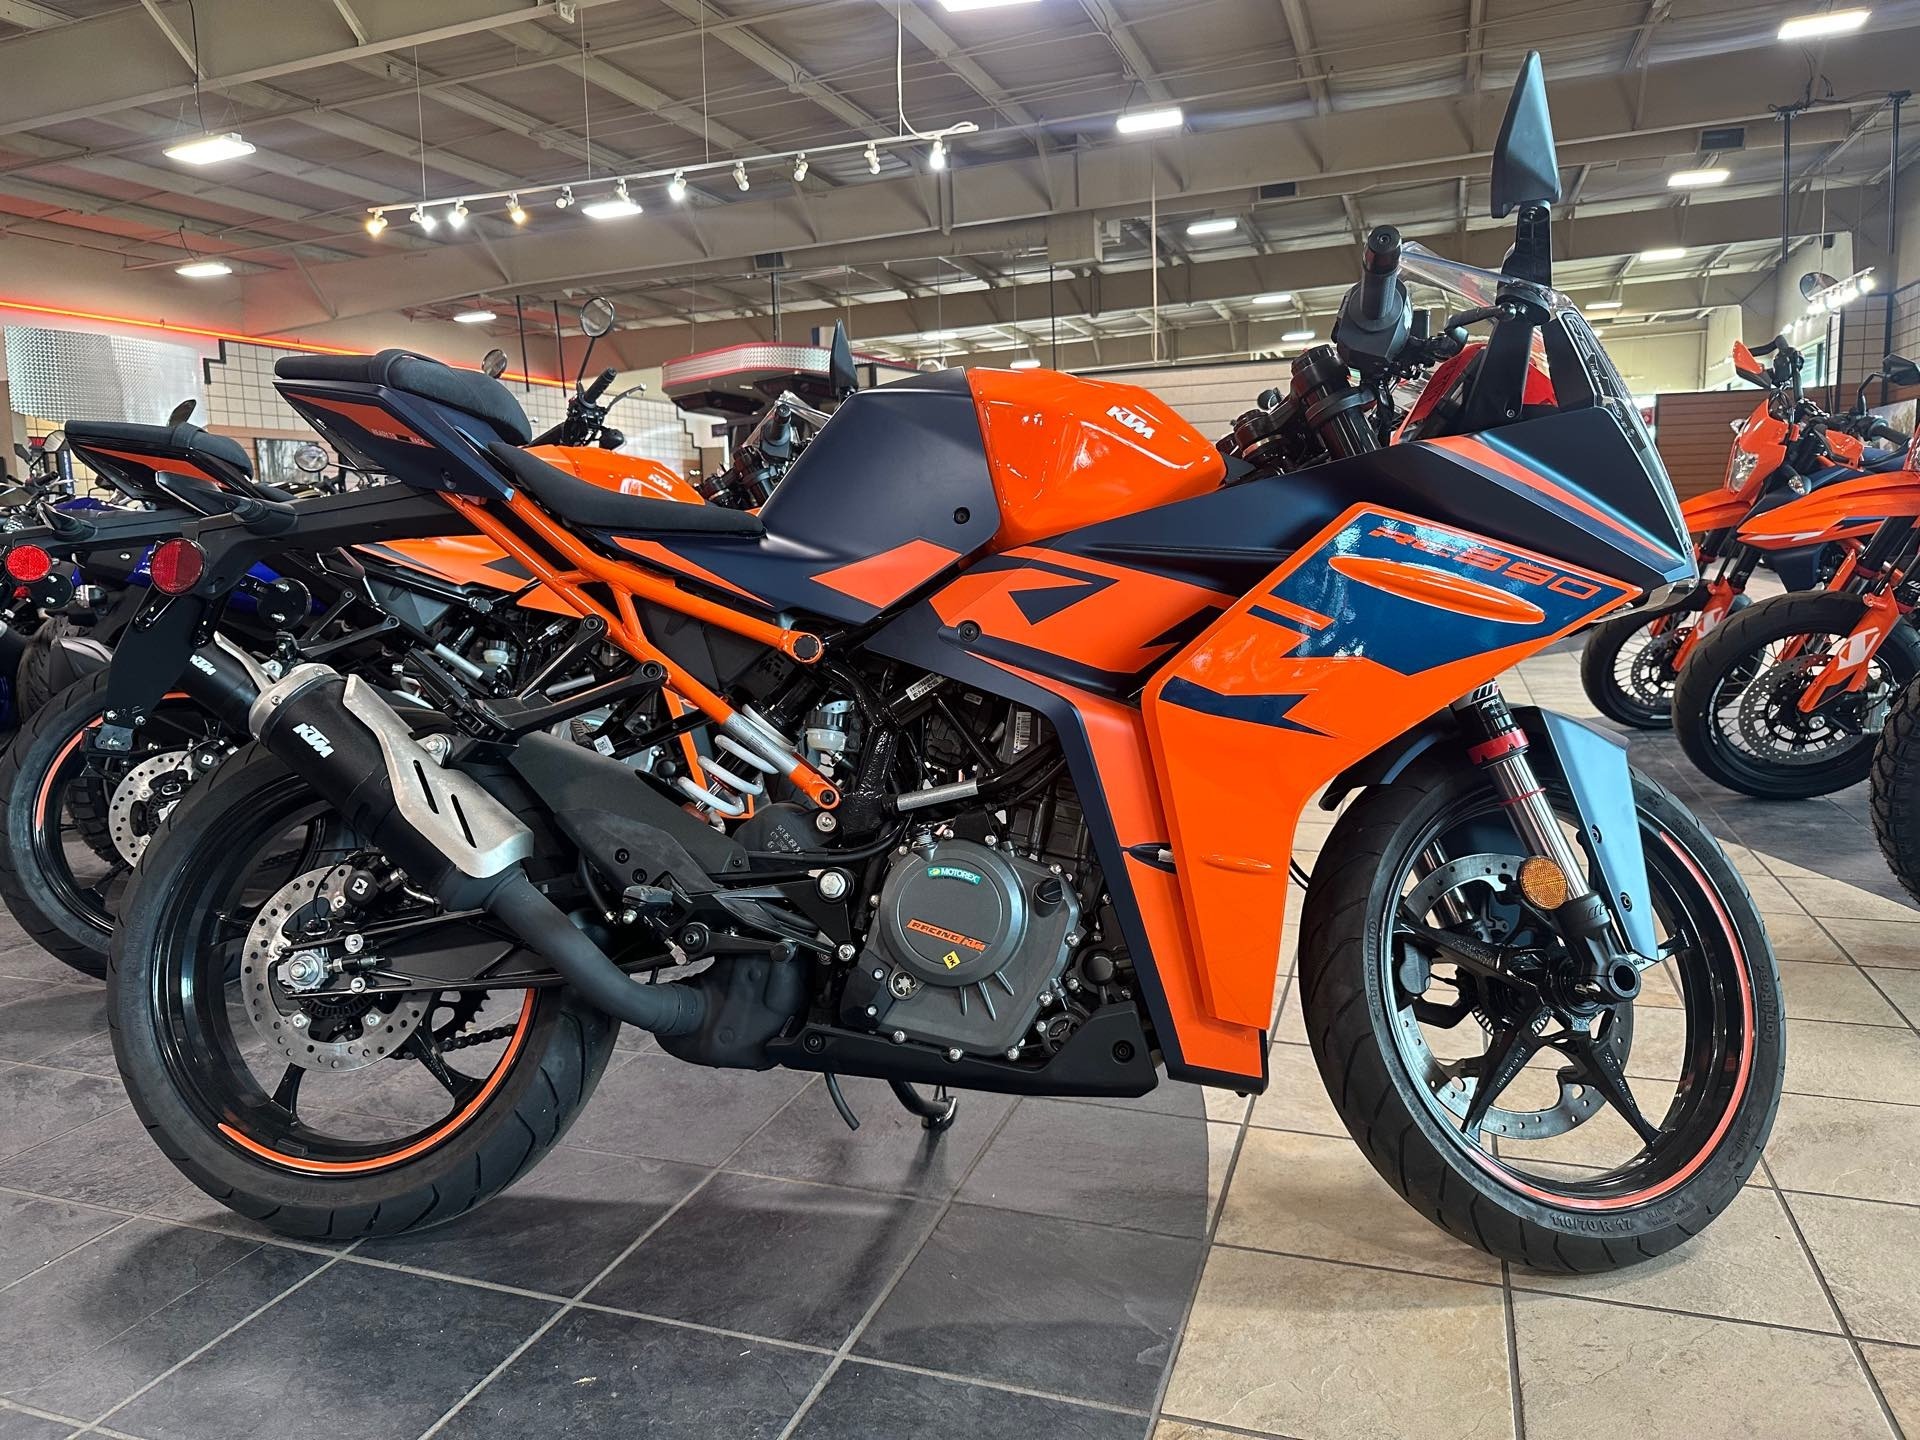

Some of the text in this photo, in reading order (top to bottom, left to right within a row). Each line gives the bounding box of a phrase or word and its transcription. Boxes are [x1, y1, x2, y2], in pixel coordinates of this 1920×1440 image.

[1105, 405, 1156, 440] KTM
[647, 473, 673, 492] KTM
[190, 654, 217, 675] KTM
[292, 722, 335, 758] KTM
[940, 867, 980, 884] MOTOREX
[911, 921, 961, 942] RACING
[947, 954, 956, 966] OK
[1551, 1212, 1598, 1232] 110/70
[1615, 1217, 1633, 1232] 17
